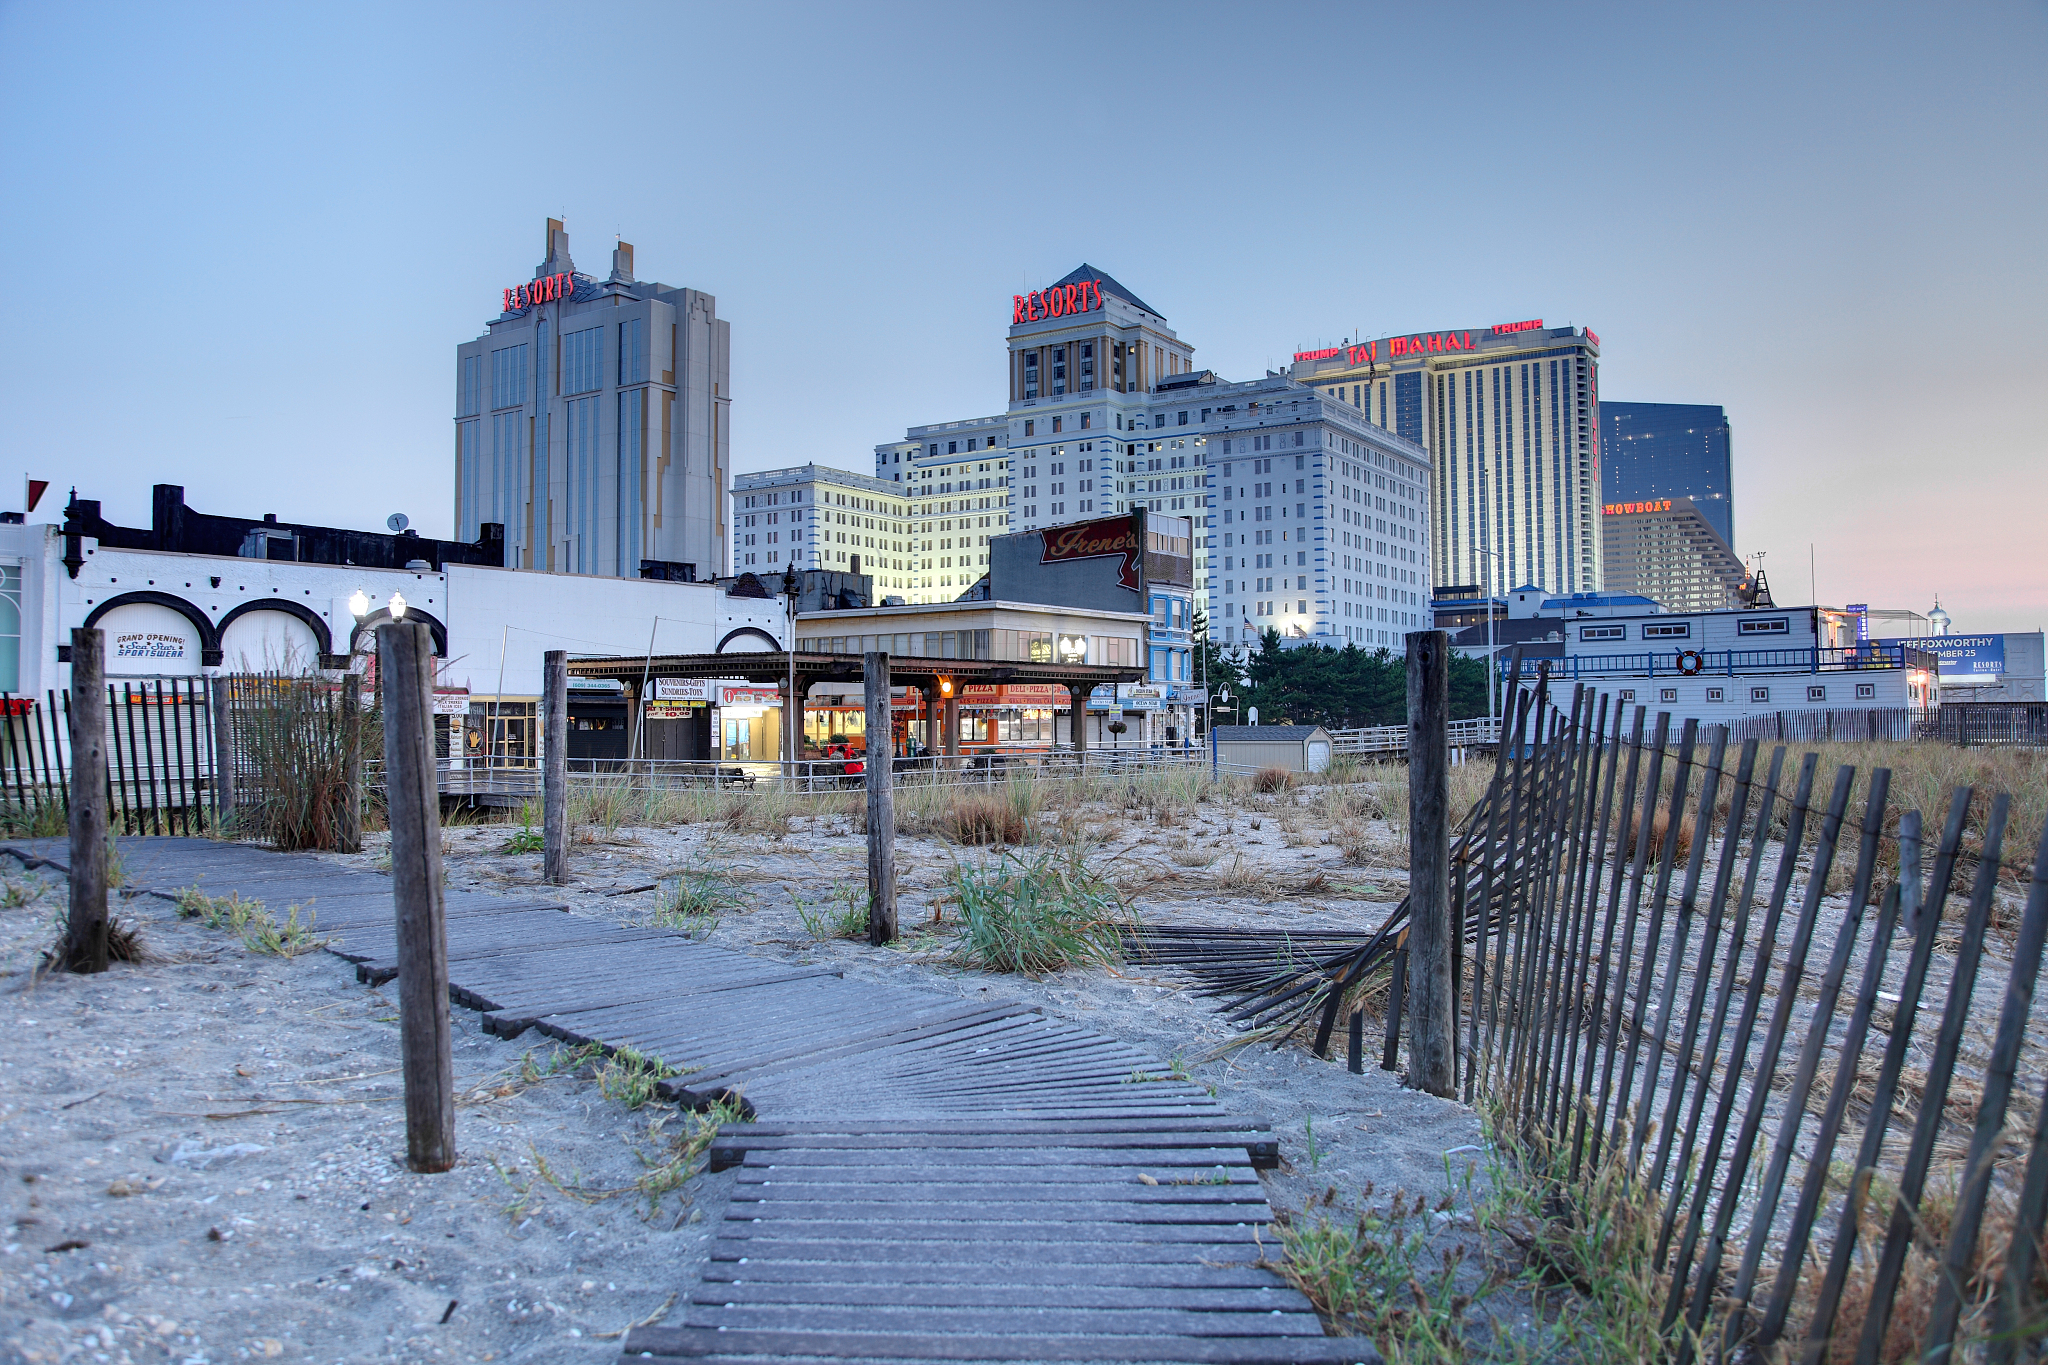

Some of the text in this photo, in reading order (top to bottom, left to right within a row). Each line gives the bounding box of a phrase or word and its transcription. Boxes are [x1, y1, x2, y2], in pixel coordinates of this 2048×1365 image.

[503, 270, 574, 312] RESORTS
[1013, 279, 1102, 324] RESORTS
[1492, 319, 1543, 335] TRUMP
[1294, 347, 1339, 362] TRUMP
[1347, 331, 1477, 365] TAJ MAHAL
[1601, 500, 1672, 516] SHOWBOAT
[1051, 526, 1139, 556] Irene's
[117, 634, 186, 645] GRAND OPENING!
[126, 641, 176, 650] Sea Star
[1920, 637, 1994, 649] FOXWORTHY
[118, 649, 184, 658] SPORTSWEAR
[1965, 649, 1976, 657] 25
[968, 684, 994, 692] PIZZA
[1010, 685, 1026, 693] DELI
[1029, 685, 1049, 693] PIZZA
